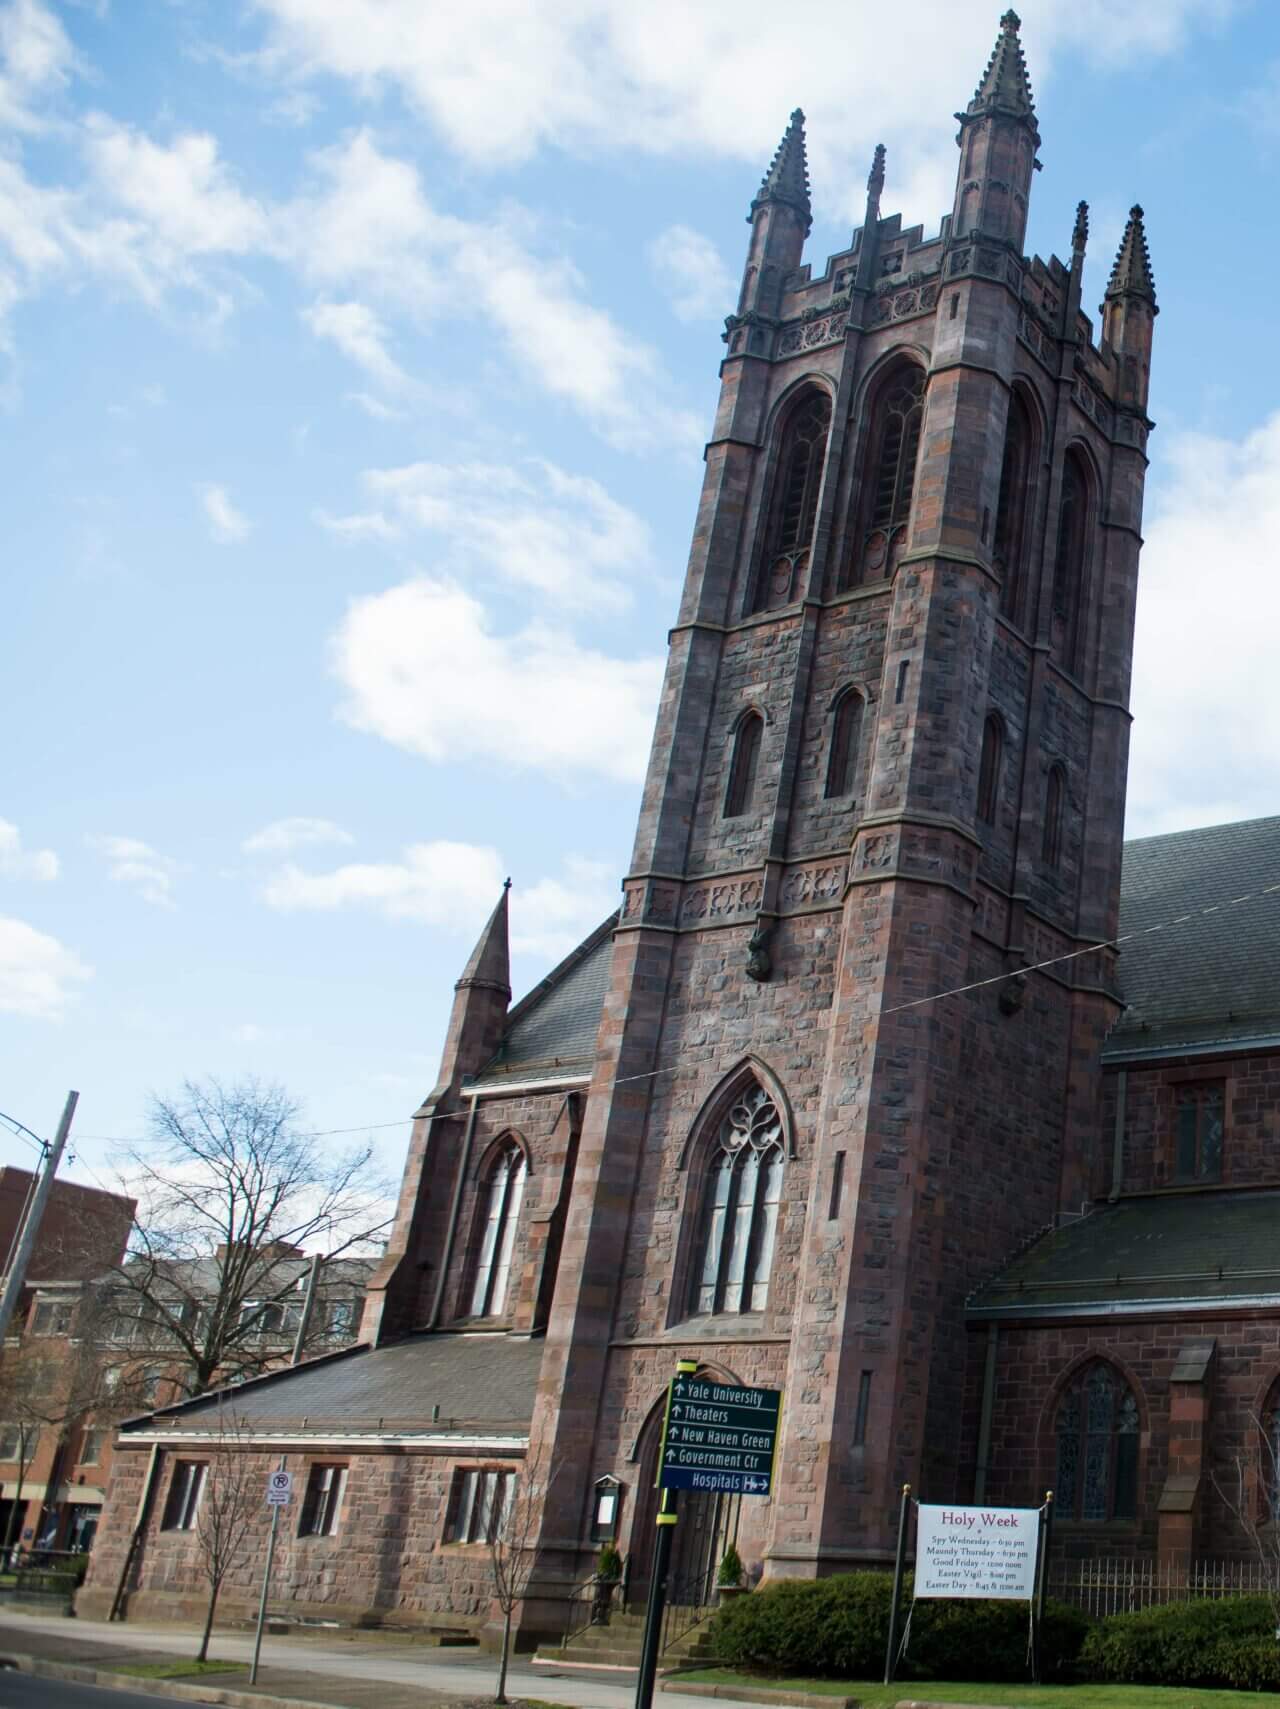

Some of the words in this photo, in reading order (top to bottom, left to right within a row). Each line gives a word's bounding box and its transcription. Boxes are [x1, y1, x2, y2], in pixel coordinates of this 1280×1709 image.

[687, 1383, 709, 1400] Yale
[713, 1387, 763, 1408] University
[684, 1405, 728, 1423] Theaters
[681, 1428, 704, 1442] New
[707, 1432, 738, 1447] Haven
[742, 1434, 770, 1449] Green
[679, 1449, 741, 1467] Government
[744, 1454, 760, 1469] Ctr
[692, 1473, 740, 1491] Hospitals
[941, 1511, 976, 1530] Holy
[981, 1513, 1019, 1528] Week
[931, 1536, 946, 1545] Spy
[948, 1536, 990, 1546] Wednesday
[1013, 1540, 1025, 1548] pm
[926, 1547, 959, 1556] Maundy
[960, 1547, 995, 1558] Thursday
[1017, 1551, 1028, 1559] pm
[932, 1558, 954, 1567] Good
[955, 1559, 979, 1568] Friday
[938, 1569, 961, 1578] Easter
[963, 1570, 982, 1580] Vigil
[1005, 1573, 1017, 1581] pm
[926, 1580, 950, 1589] Easter
[952, 1581, 968, 1591] Day
